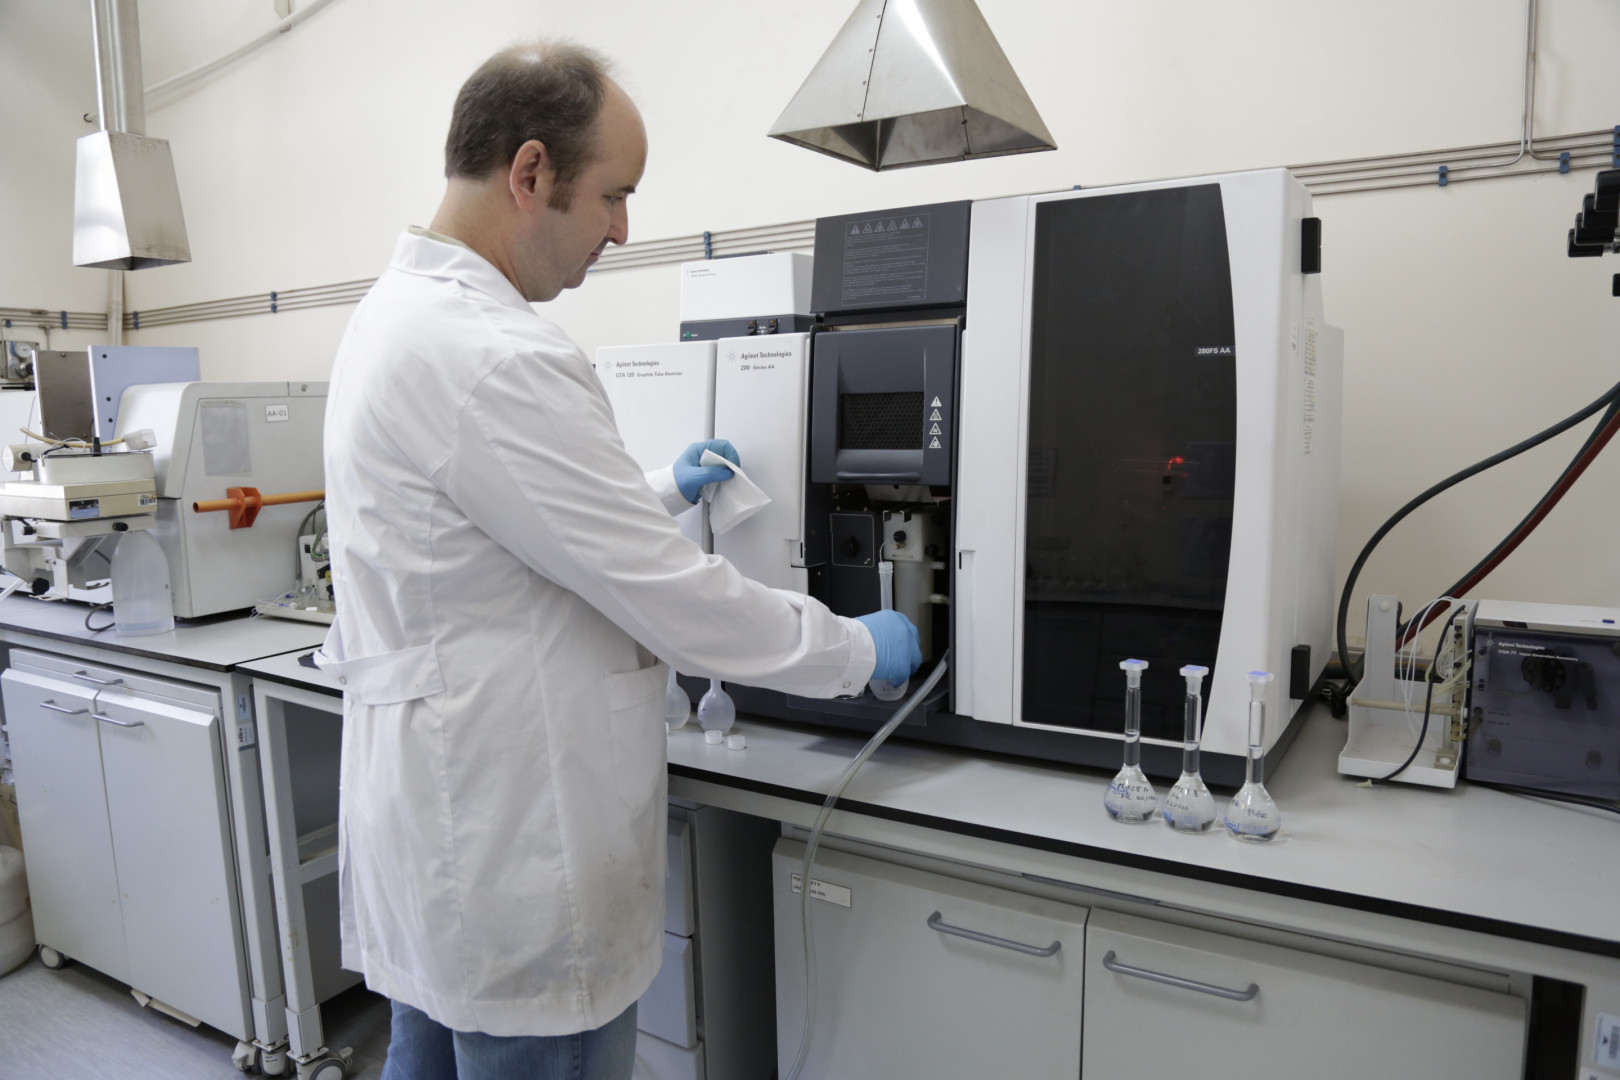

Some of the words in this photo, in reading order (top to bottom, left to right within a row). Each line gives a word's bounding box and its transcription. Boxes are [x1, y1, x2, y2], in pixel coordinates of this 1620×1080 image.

[1197, 347, 1219, 355] 280FS
[740, 352, 759, 361] Agilent
[759, 351, 792, 359] Technologies
[631, 360, 660, 368] Technologies
[267, 409, 287, 417] AA-01
